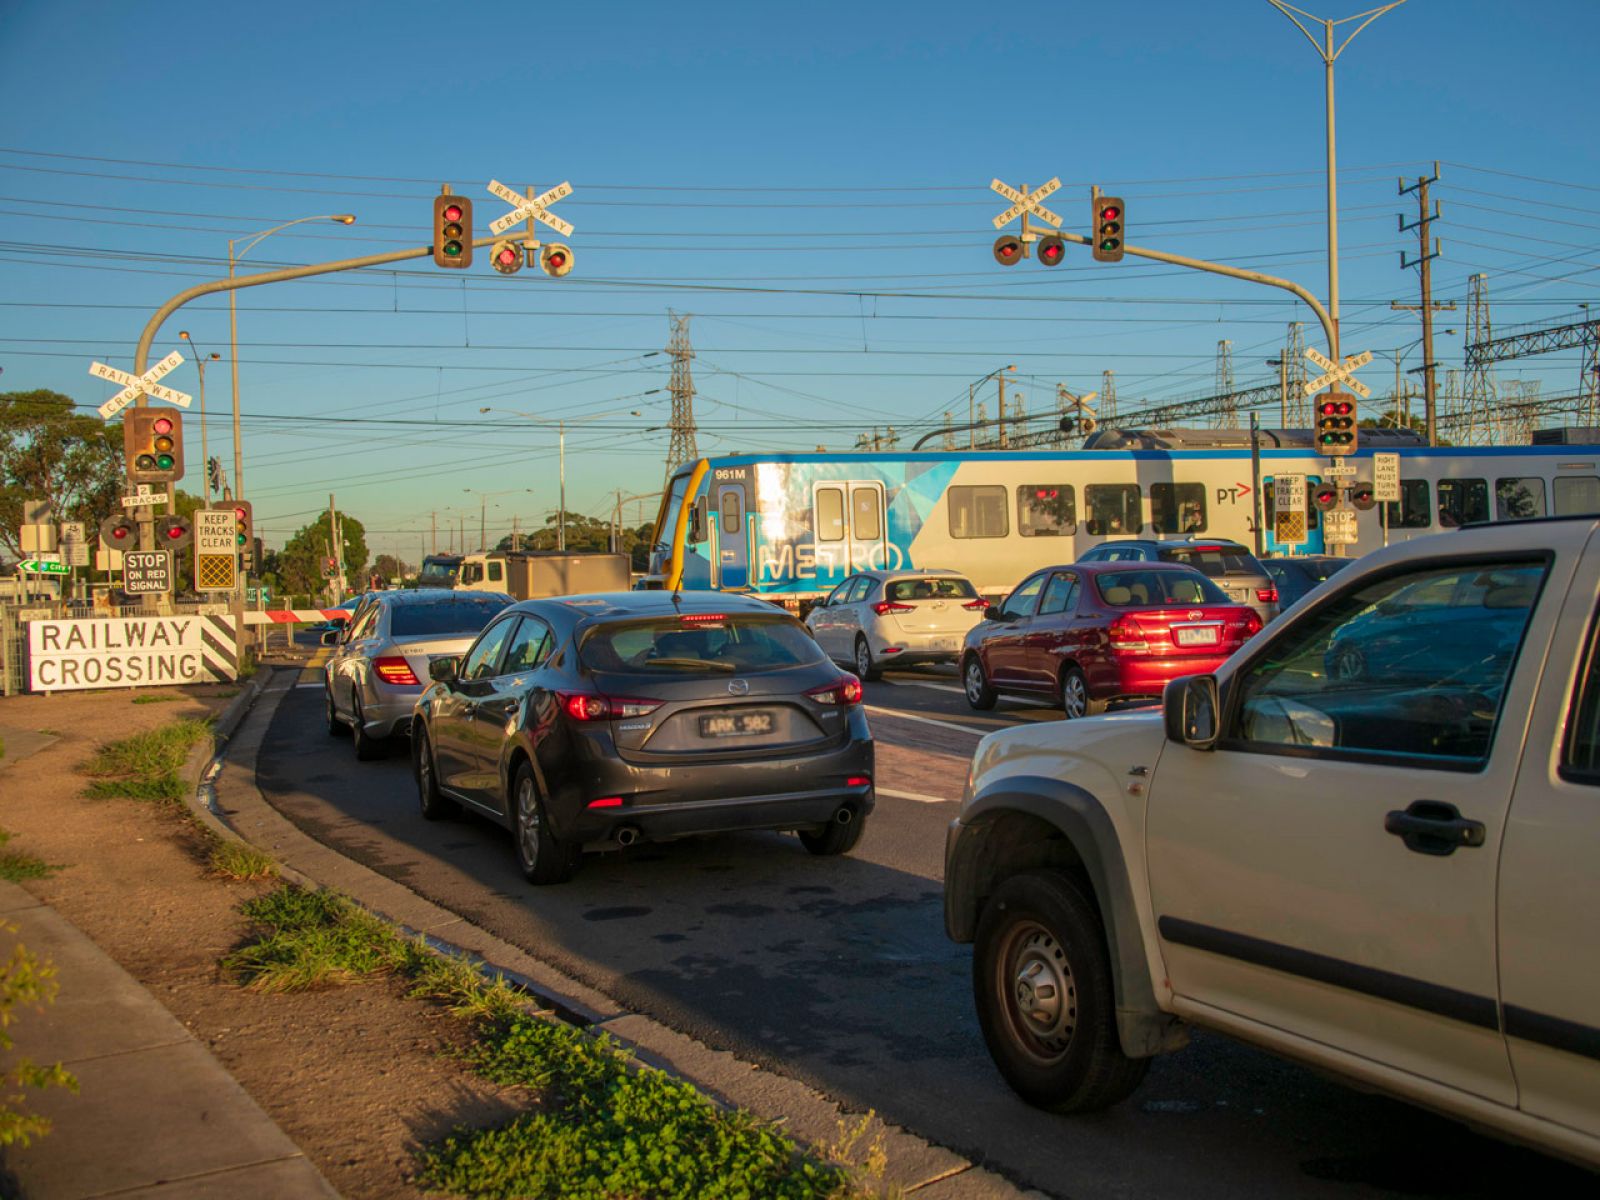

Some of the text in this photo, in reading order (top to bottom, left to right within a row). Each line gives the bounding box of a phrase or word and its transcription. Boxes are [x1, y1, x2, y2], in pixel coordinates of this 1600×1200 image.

[494, 186, 567, 231] RAILWAY
[497, 186, 566, 230] CROSSING
[98, 366, 184, 403] RAILWAY
[106, 357, 177, 412] CROSSING
[715, 469, 746, 480] 961M
[140, 486, 148, 495] 2
[204, 515, 228, 525] KEEP
[1326, 512, 1355, 522] STOP
[200, 526, 235, 536] TRACKS
[201, 538, 232, 547] CLEAR
[128, 554, 166, 568] STOP
[759, 542, 903, 580] METRO
[128, 570, 166, 580] ON RED
[130, 581, 166, 591] SIGNAL
[42, 620, 191, 651] RAILWAY
[38, 654, 197, 686] CROSSING
